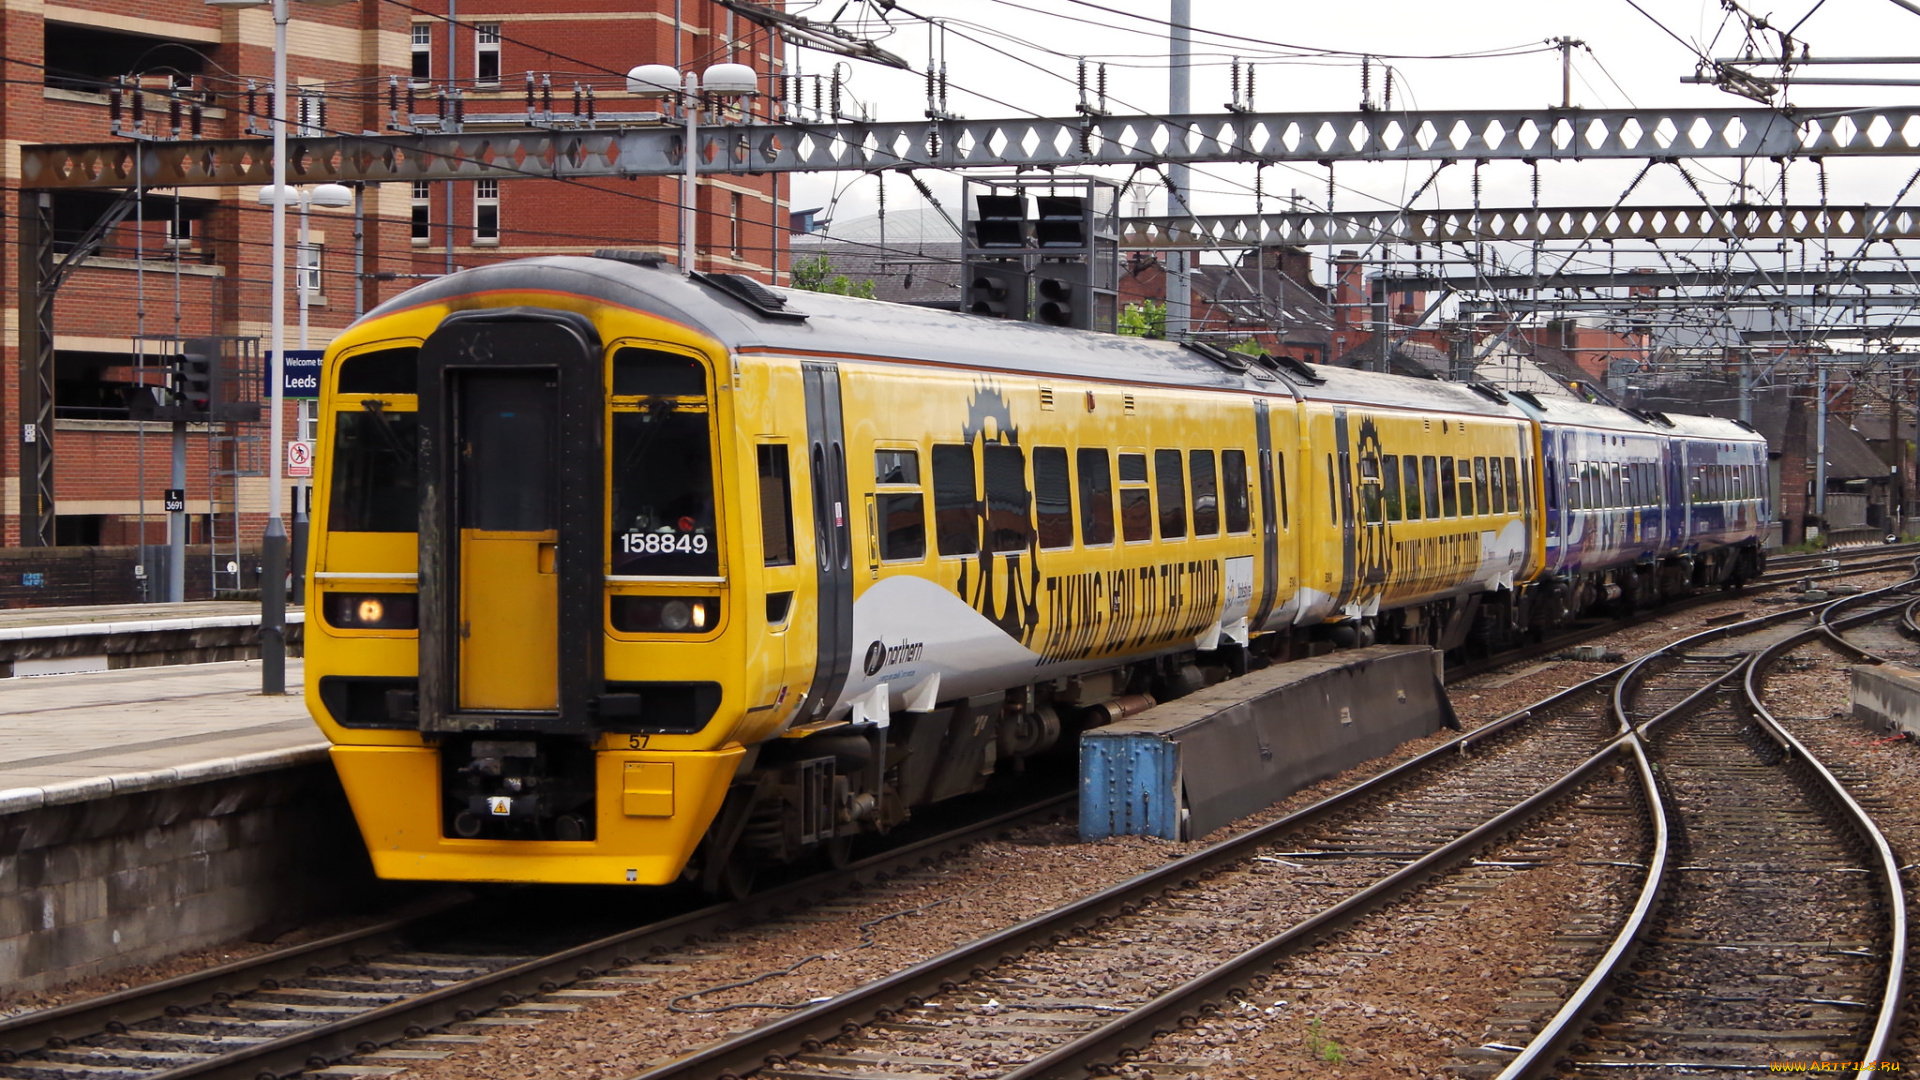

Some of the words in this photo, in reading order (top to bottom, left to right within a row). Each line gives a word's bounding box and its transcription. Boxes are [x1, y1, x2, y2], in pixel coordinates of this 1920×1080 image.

[285, 357, 316, 367] Welcome
[285, 374, 317, 388] Leeds
[172, 491, 177, 499] L
[166, 501, 182, 510] 3691
[621, 533, 708, 554] 158849
[1035, 571, 1102, 667] TAKING
[1097, 568, 1136, 654] YOU
[1130, 565, 1156, 648] TO
[1151, 562, 1184, 643] THE
[1179, 559, 1219, 638] TOUR
[884, 638, 923, 666] northern
[629, 735, 650, 749] 57
